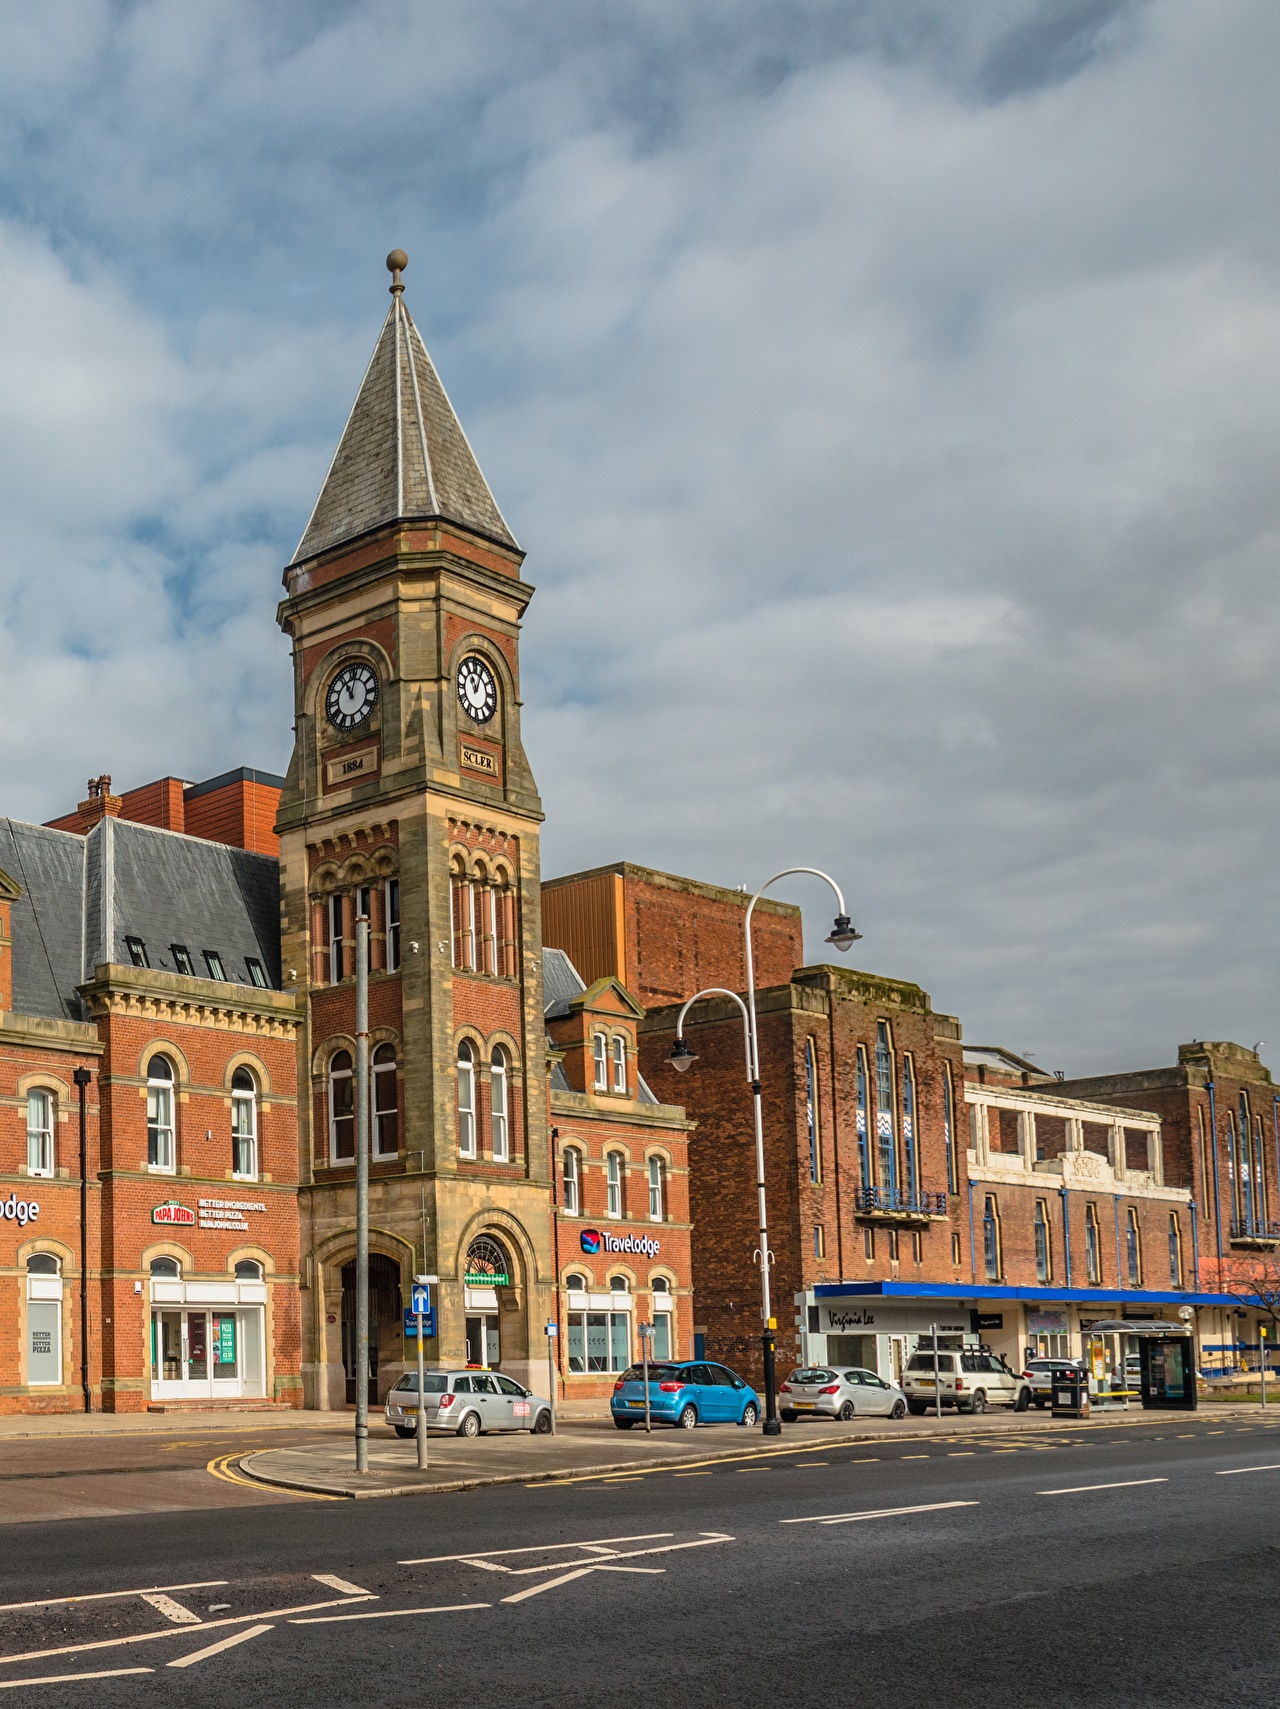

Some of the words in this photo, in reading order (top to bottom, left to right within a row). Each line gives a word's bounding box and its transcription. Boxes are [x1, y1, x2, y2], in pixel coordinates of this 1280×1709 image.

[342, 758, 364, 774] 1884
[464, 751, 492, 770] SCLER
[200, 1199, 224, 1208] BETTER
[155, 1208, 172, 1222] PAPA
[173, 1207, 194, 1222] JOHNS
[200, 1210, 224, 1218] BETTER
[601, 1232, 660, 1258] Travelodge
[828, 1310, 862, 1332] Virginia
[864, 1308, 874, 1326] Lee
